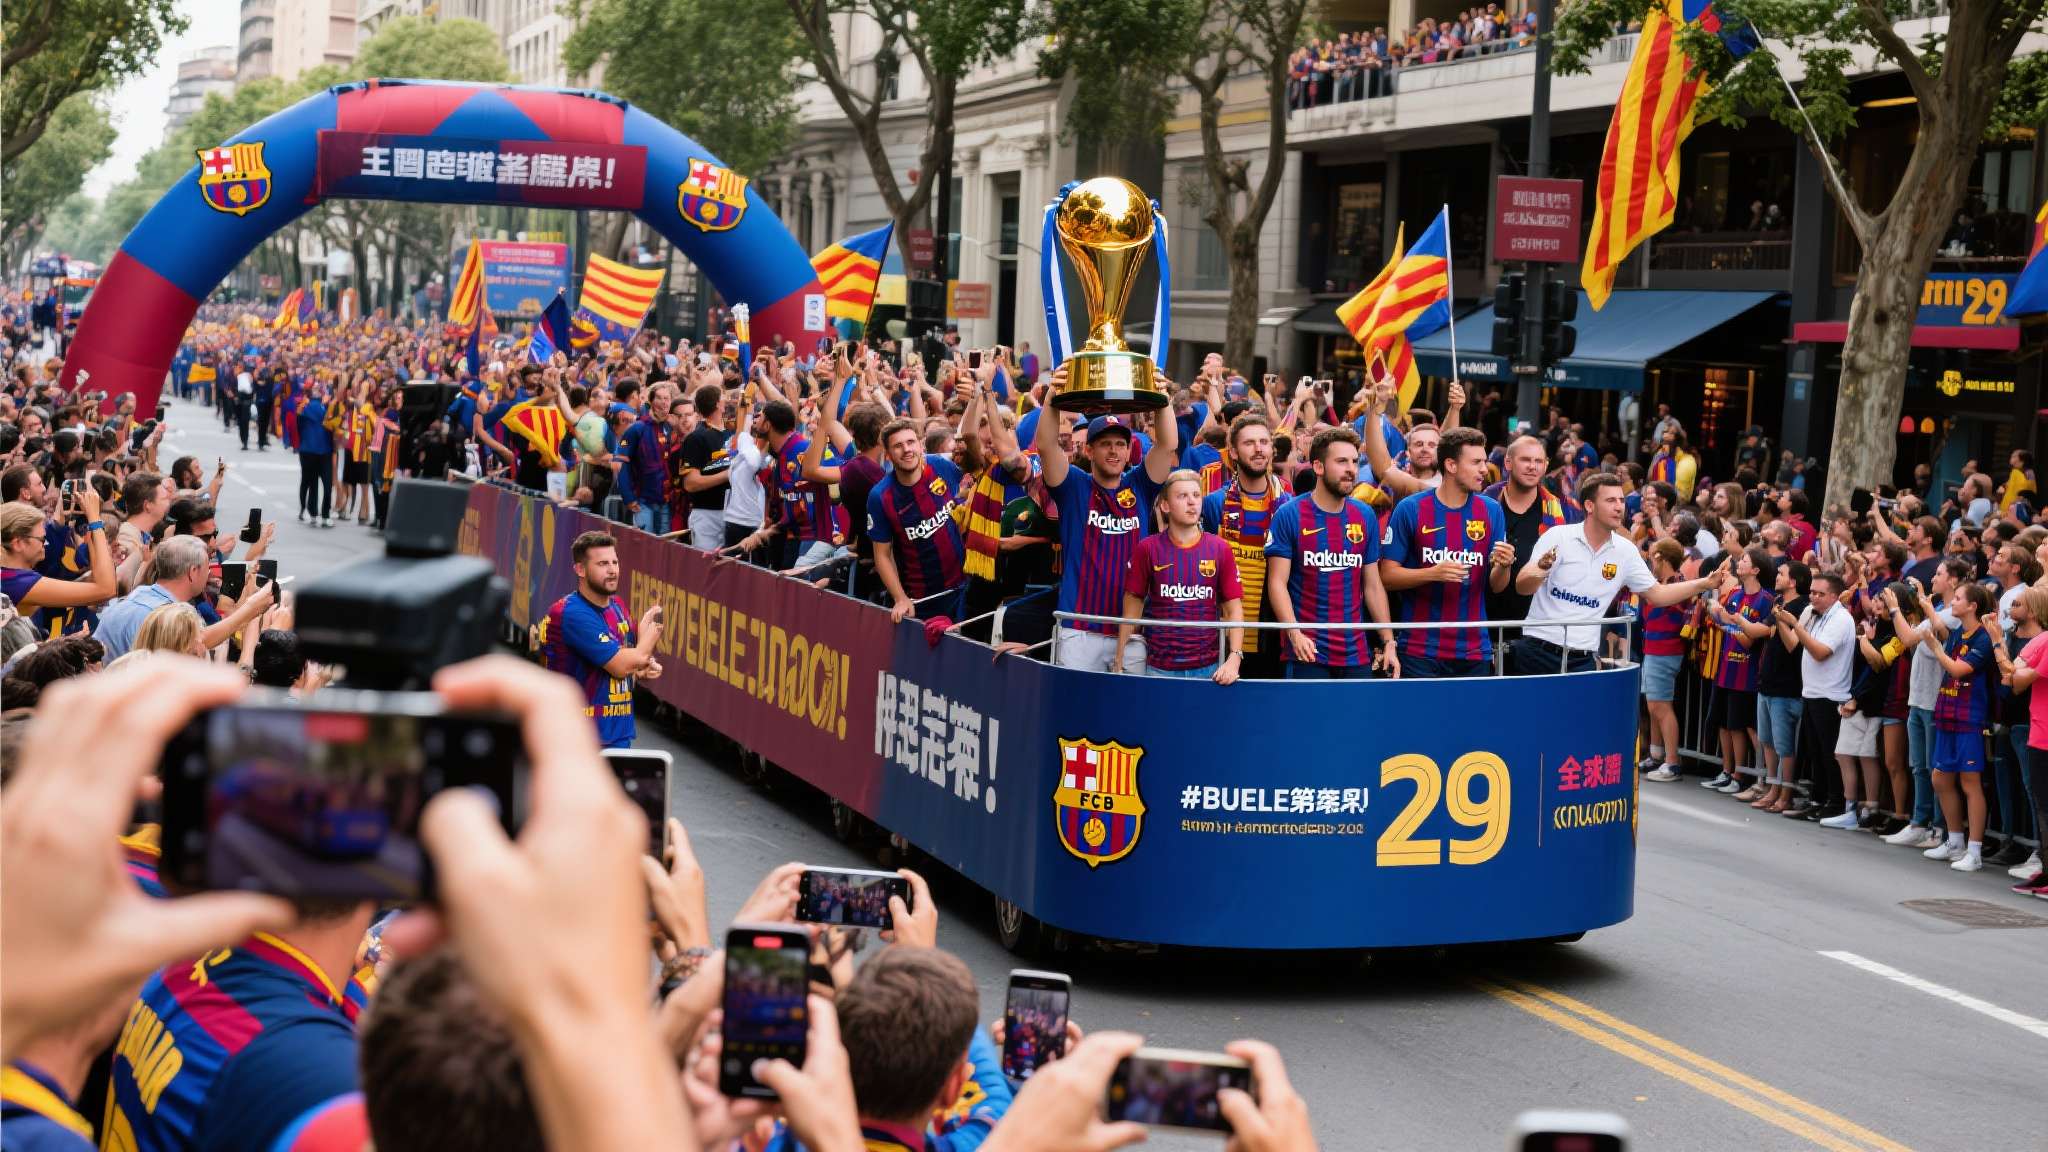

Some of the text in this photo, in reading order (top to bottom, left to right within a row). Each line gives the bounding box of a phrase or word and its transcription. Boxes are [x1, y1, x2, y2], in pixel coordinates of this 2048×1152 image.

[1303, 549, 1363, 569] Rakuten
[1080, 792, 1114, 810] FCB
[1376, 750, 1511, 867] 29
